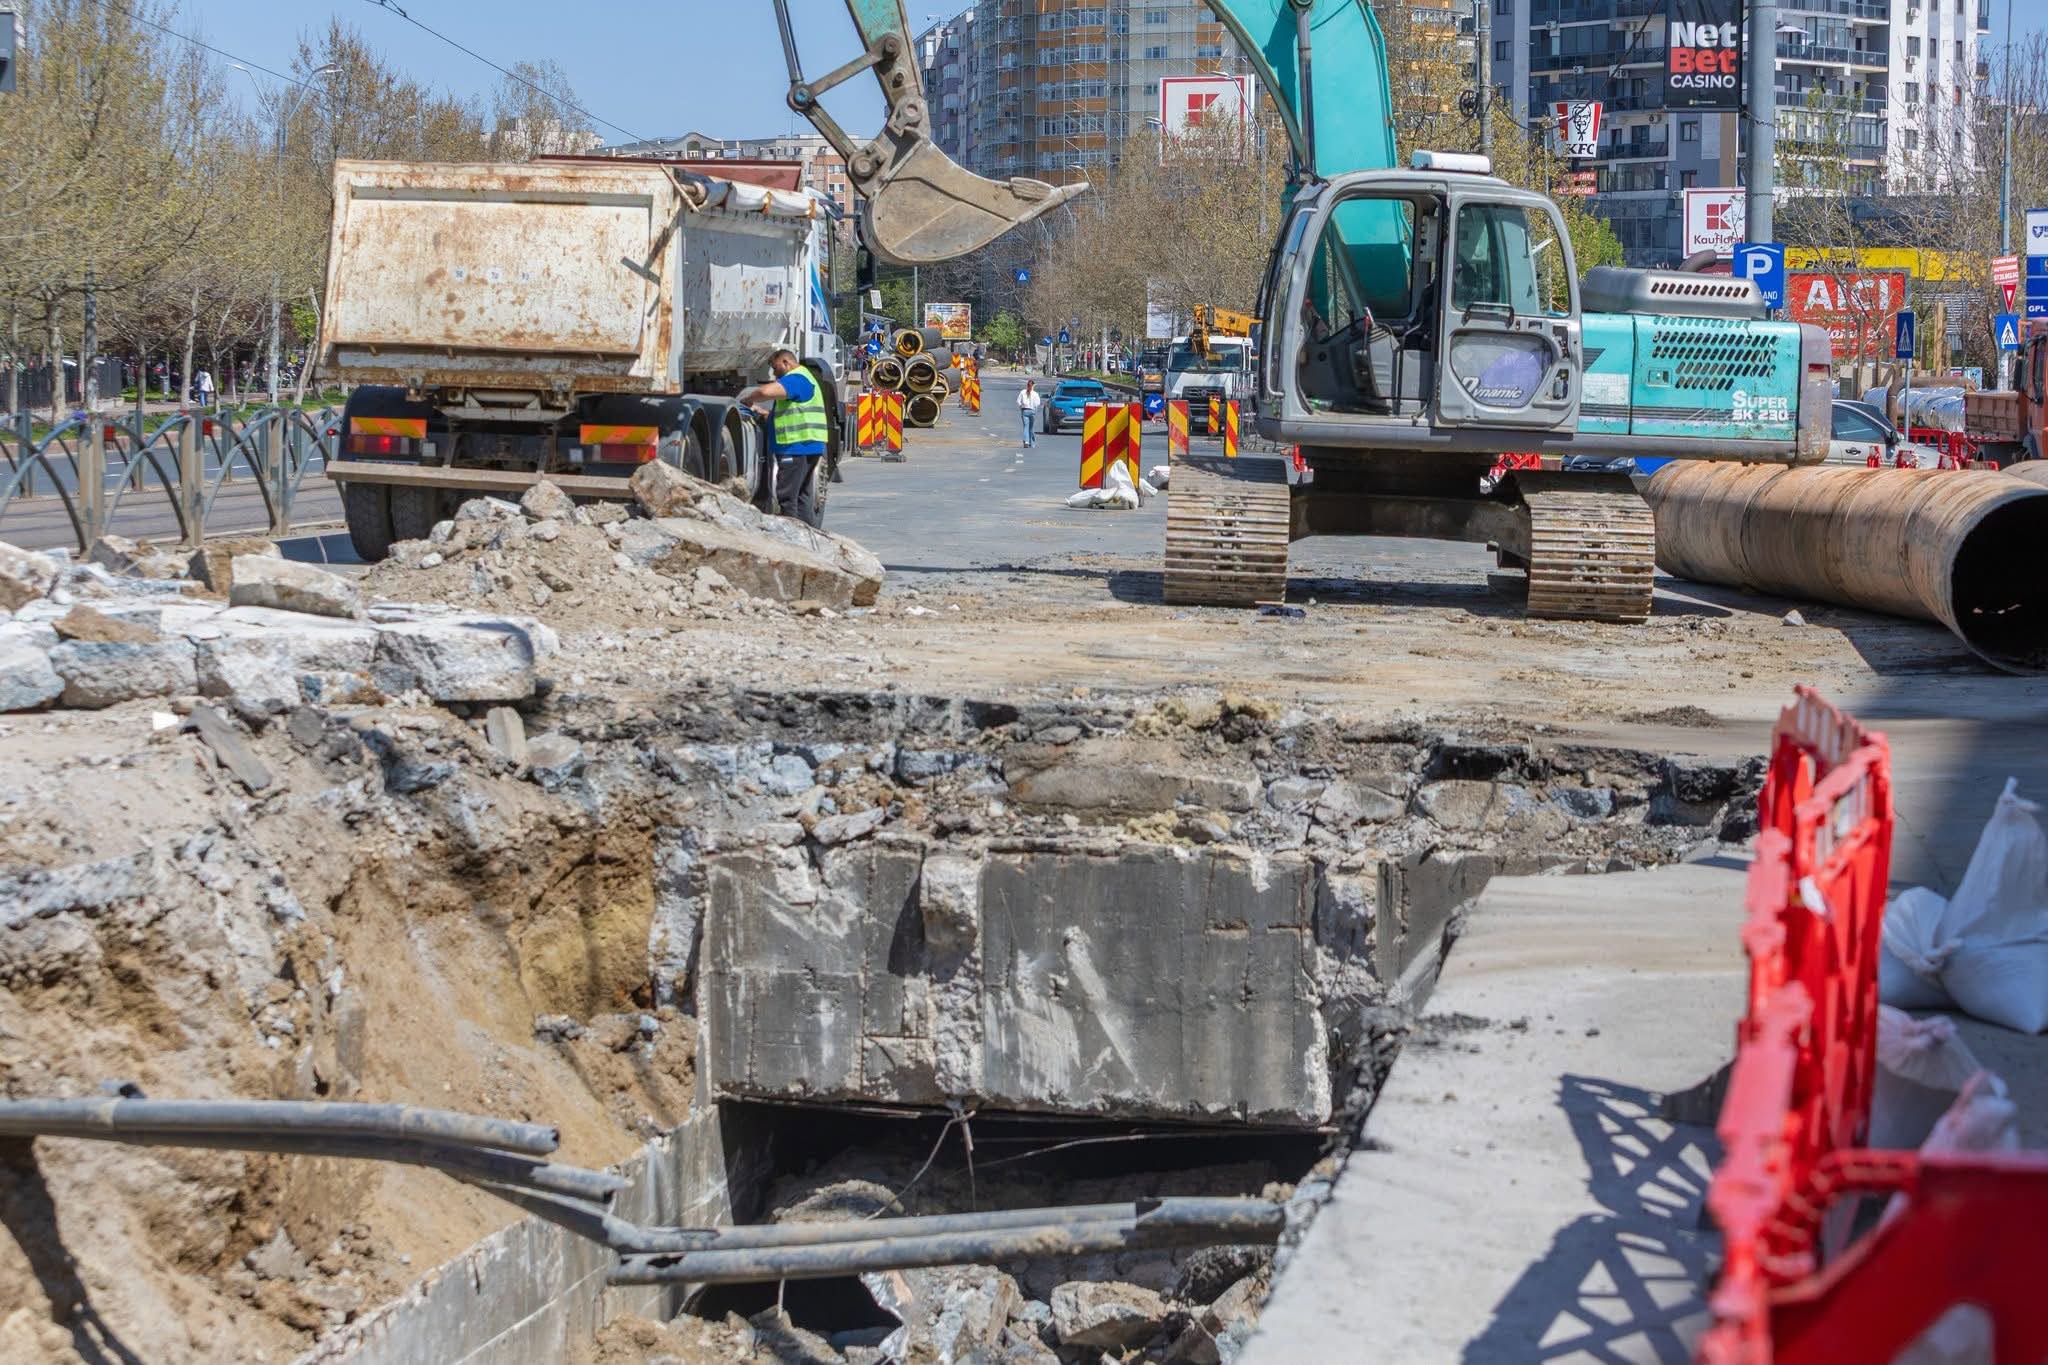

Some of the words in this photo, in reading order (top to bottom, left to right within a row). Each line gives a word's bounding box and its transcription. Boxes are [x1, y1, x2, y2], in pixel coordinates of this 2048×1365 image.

[1671, 21, 1737, 48] Net
[1670, 47, 1737, 73] Bet
[1670, 74, 1736, 89] CASINO
[1567, 143, 1595, 155] KFC
[1693, 234, 1744, 245] Kaufland
[1747, 253, 1773, 281] P
[1803, 278, 1889, 311] AICI
[2028, 304, 2047, 313] GPL
[1732, 389, 1788, 409] SUPER
[1732, 409, 1753, 421] SK
[1758, 409, 1789, 422] 230
